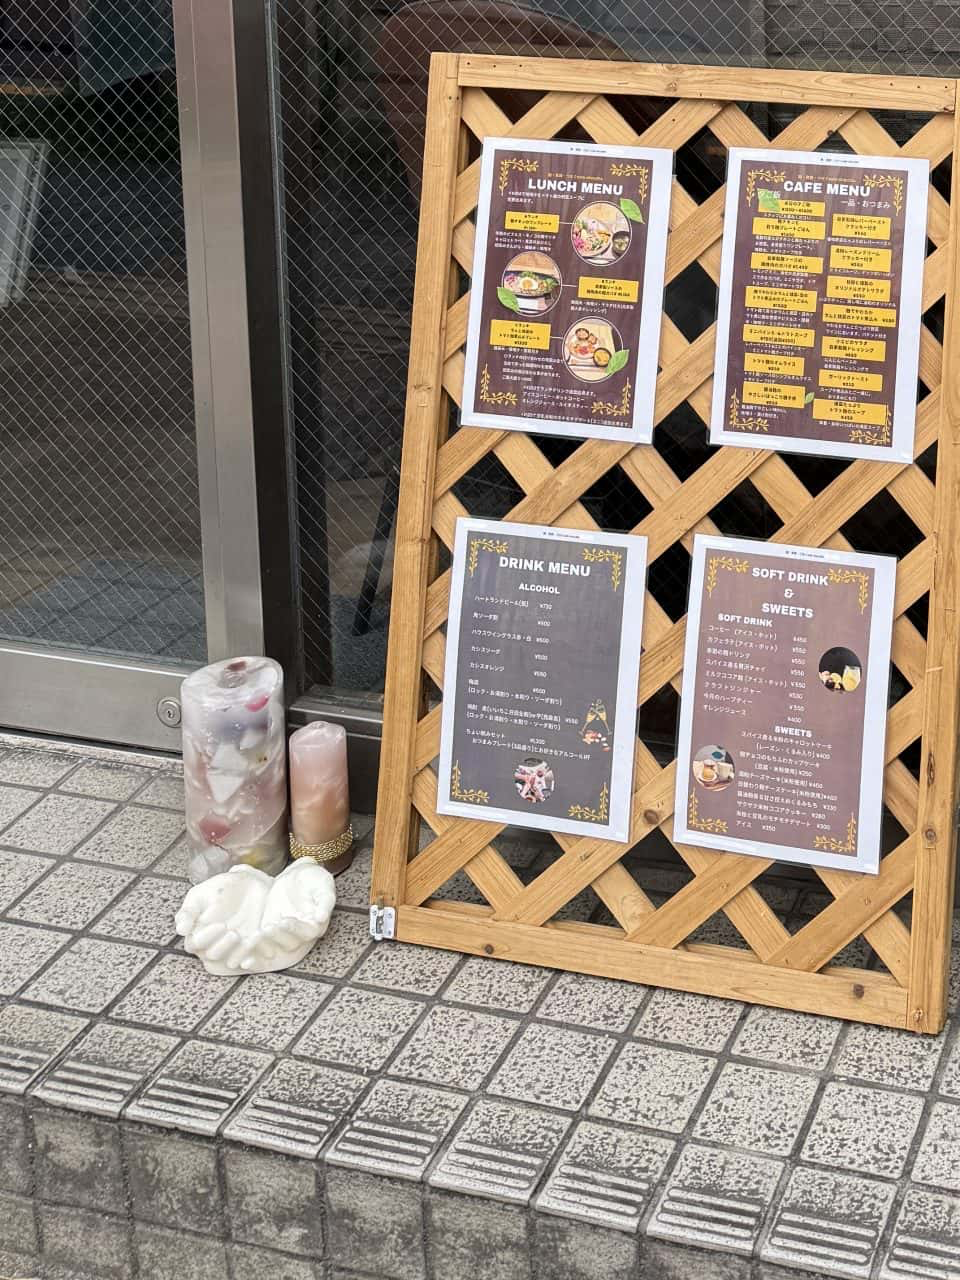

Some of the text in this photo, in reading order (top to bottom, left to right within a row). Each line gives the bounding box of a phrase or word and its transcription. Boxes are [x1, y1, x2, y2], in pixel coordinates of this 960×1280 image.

[528, 178, 577, 193] LUNCH
[581, 182, 624, 196] MENU
[783, 180, 871, 197] CAFE MENU
[499, 556, 591, 577] DRINK MENU
[751, 567, 829, 586] SOFT DRINK
[518, 583, 561, 595] ALCOHOL
[784, 588, 795, 598] &
[761, 602, 814, 618] SWEETS
[718, 613, 773, 628] SOFT DRINK
[707, 625, 731, 633] コーヒー
[469, 662, 505, 672] カシスオレンジ
[703, 704, 747, 716] オレンジジュース
[774, 726, 813, 738] SWEETS
[736, 820, 752, 828] アイス
